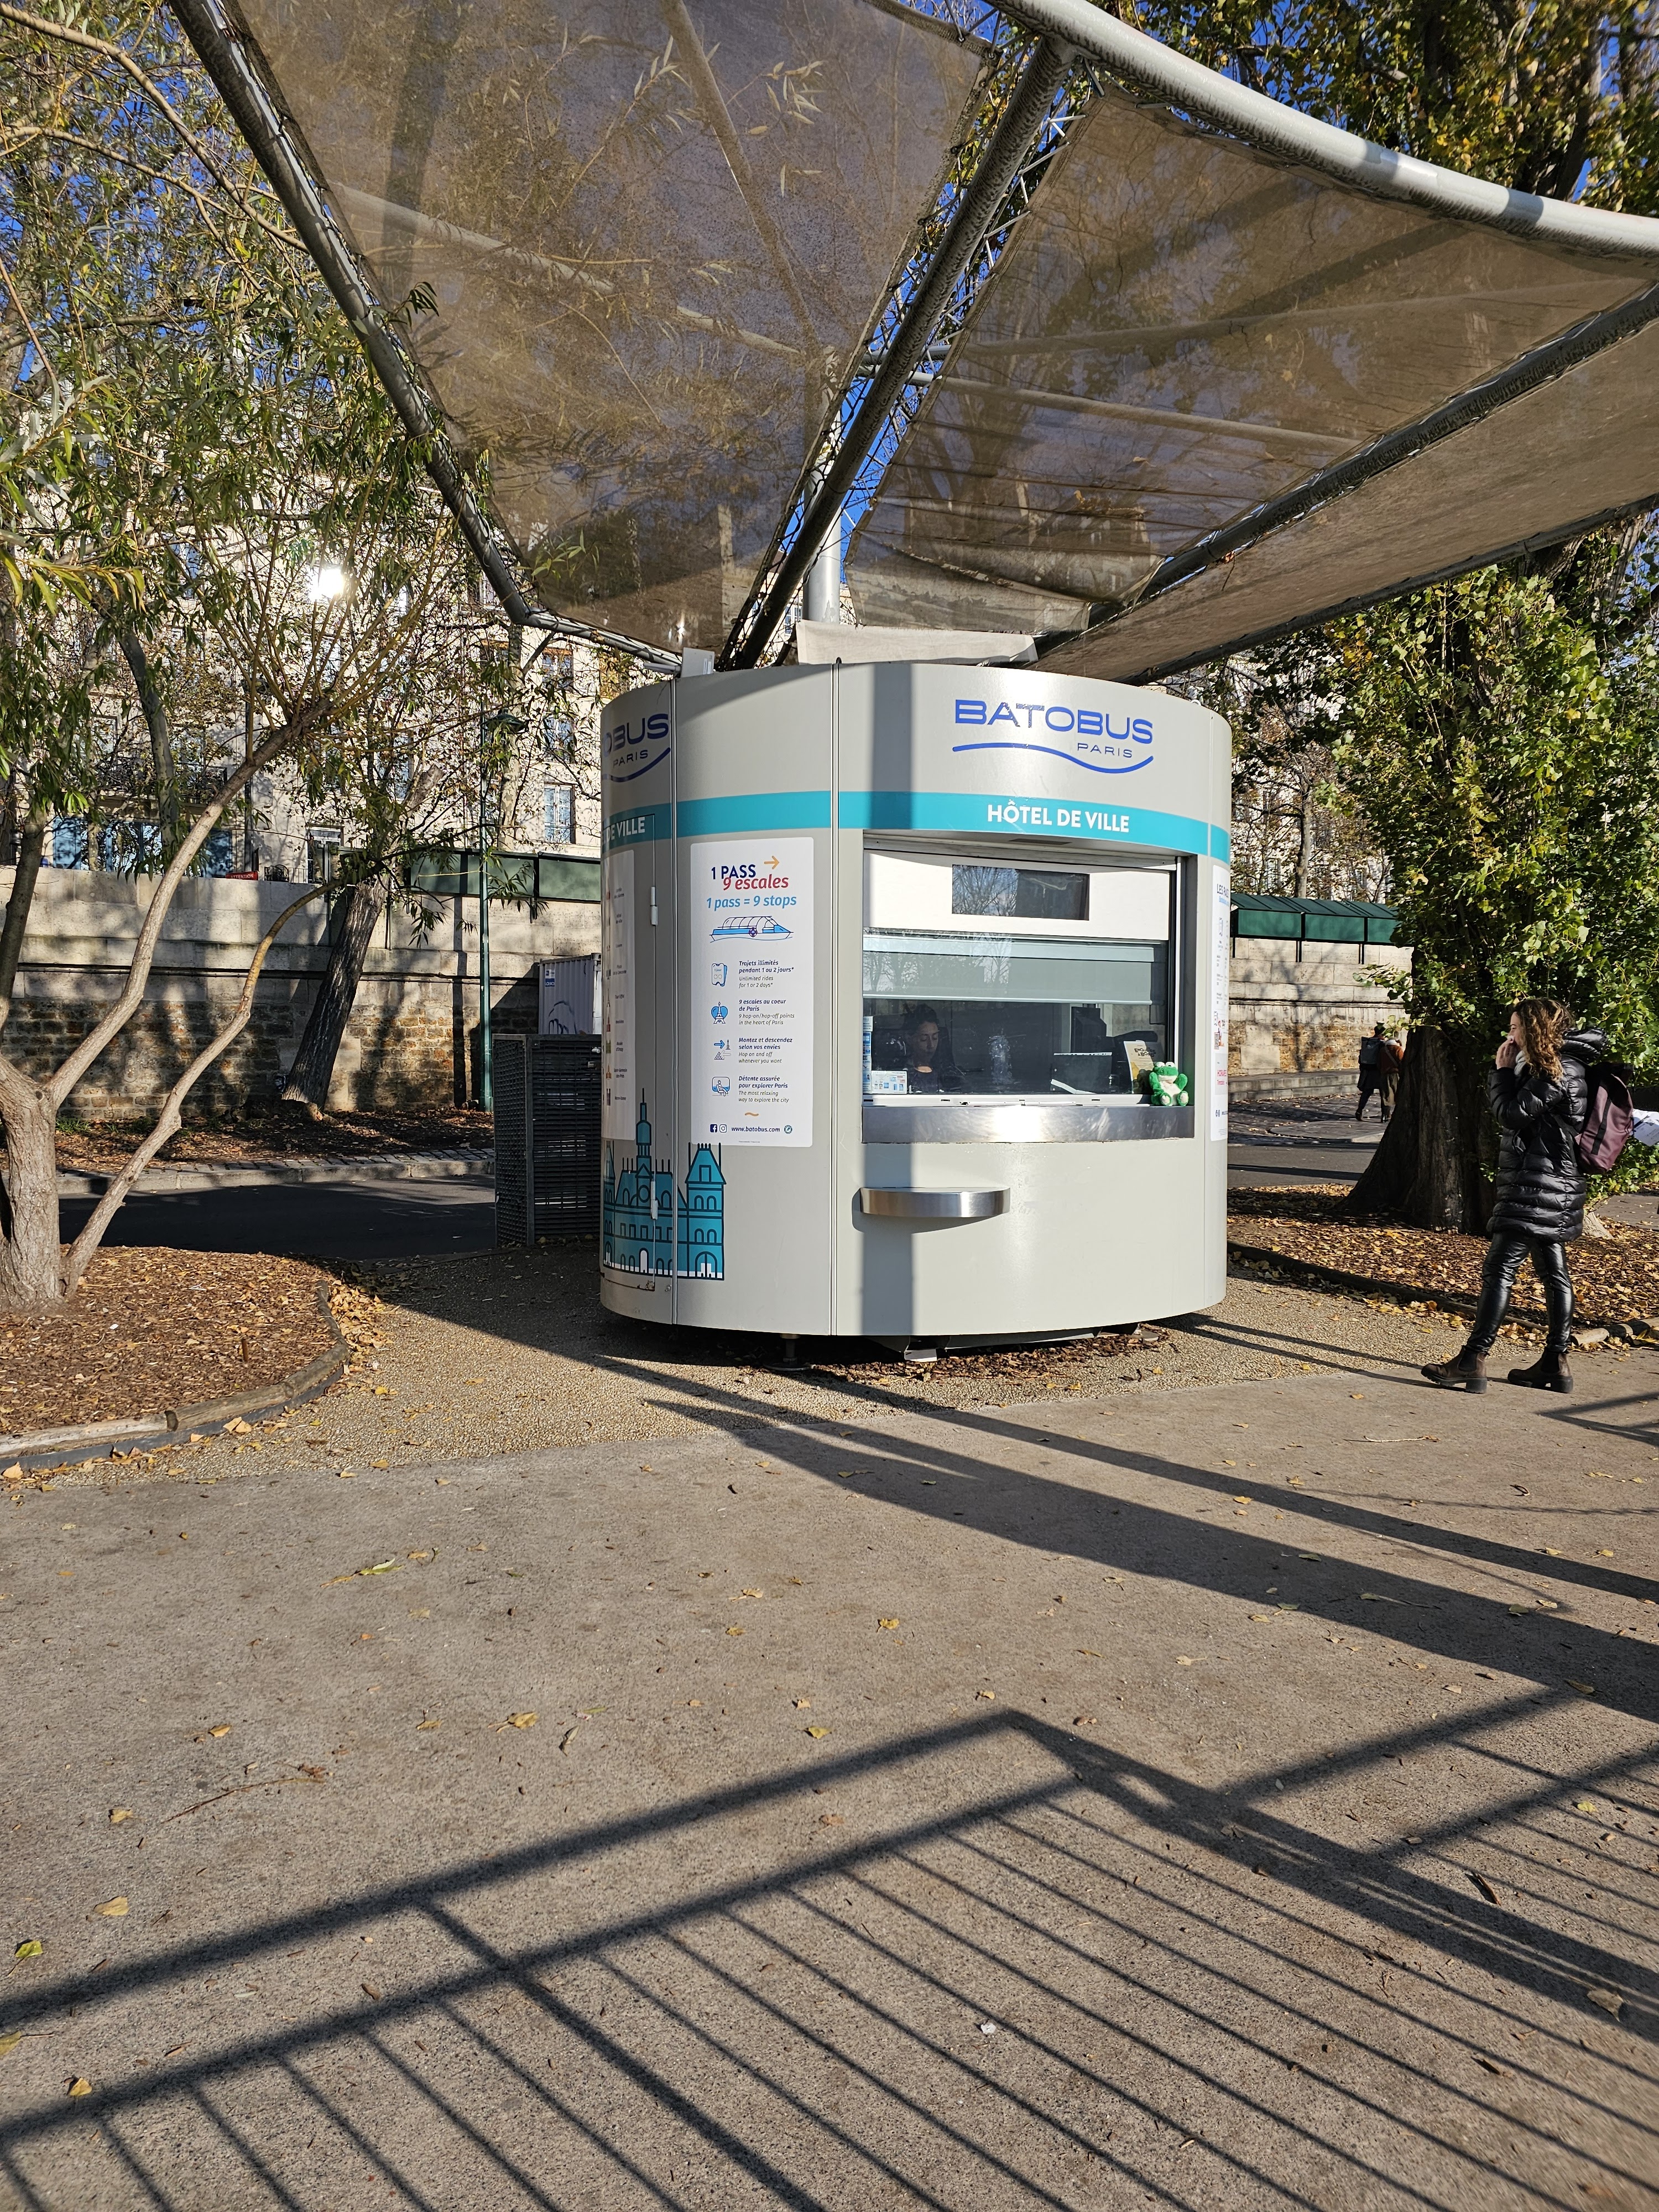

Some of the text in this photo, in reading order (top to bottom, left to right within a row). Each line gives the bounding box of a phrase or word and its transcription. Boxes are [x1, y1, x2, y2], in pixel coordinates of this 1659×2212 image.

[955, 699, 1153, 744] BATOBUS
[613, 749, 648, 768] PARIS
[1077, 742, 1133, 758] PARIS
[988, 800, 1130, 833] HÔTEL DE VILLE
[616, 816, 645, 838] VILLE
[711, 864, 757, 880] 1 PASS
[723, 874, 789, 891] 9 escales
[707, 898, 712, 909] 1
[714, 898, 740, 912] pass
[753, 895, 760, 907] 9
[763, 895, 797, 909] stops
